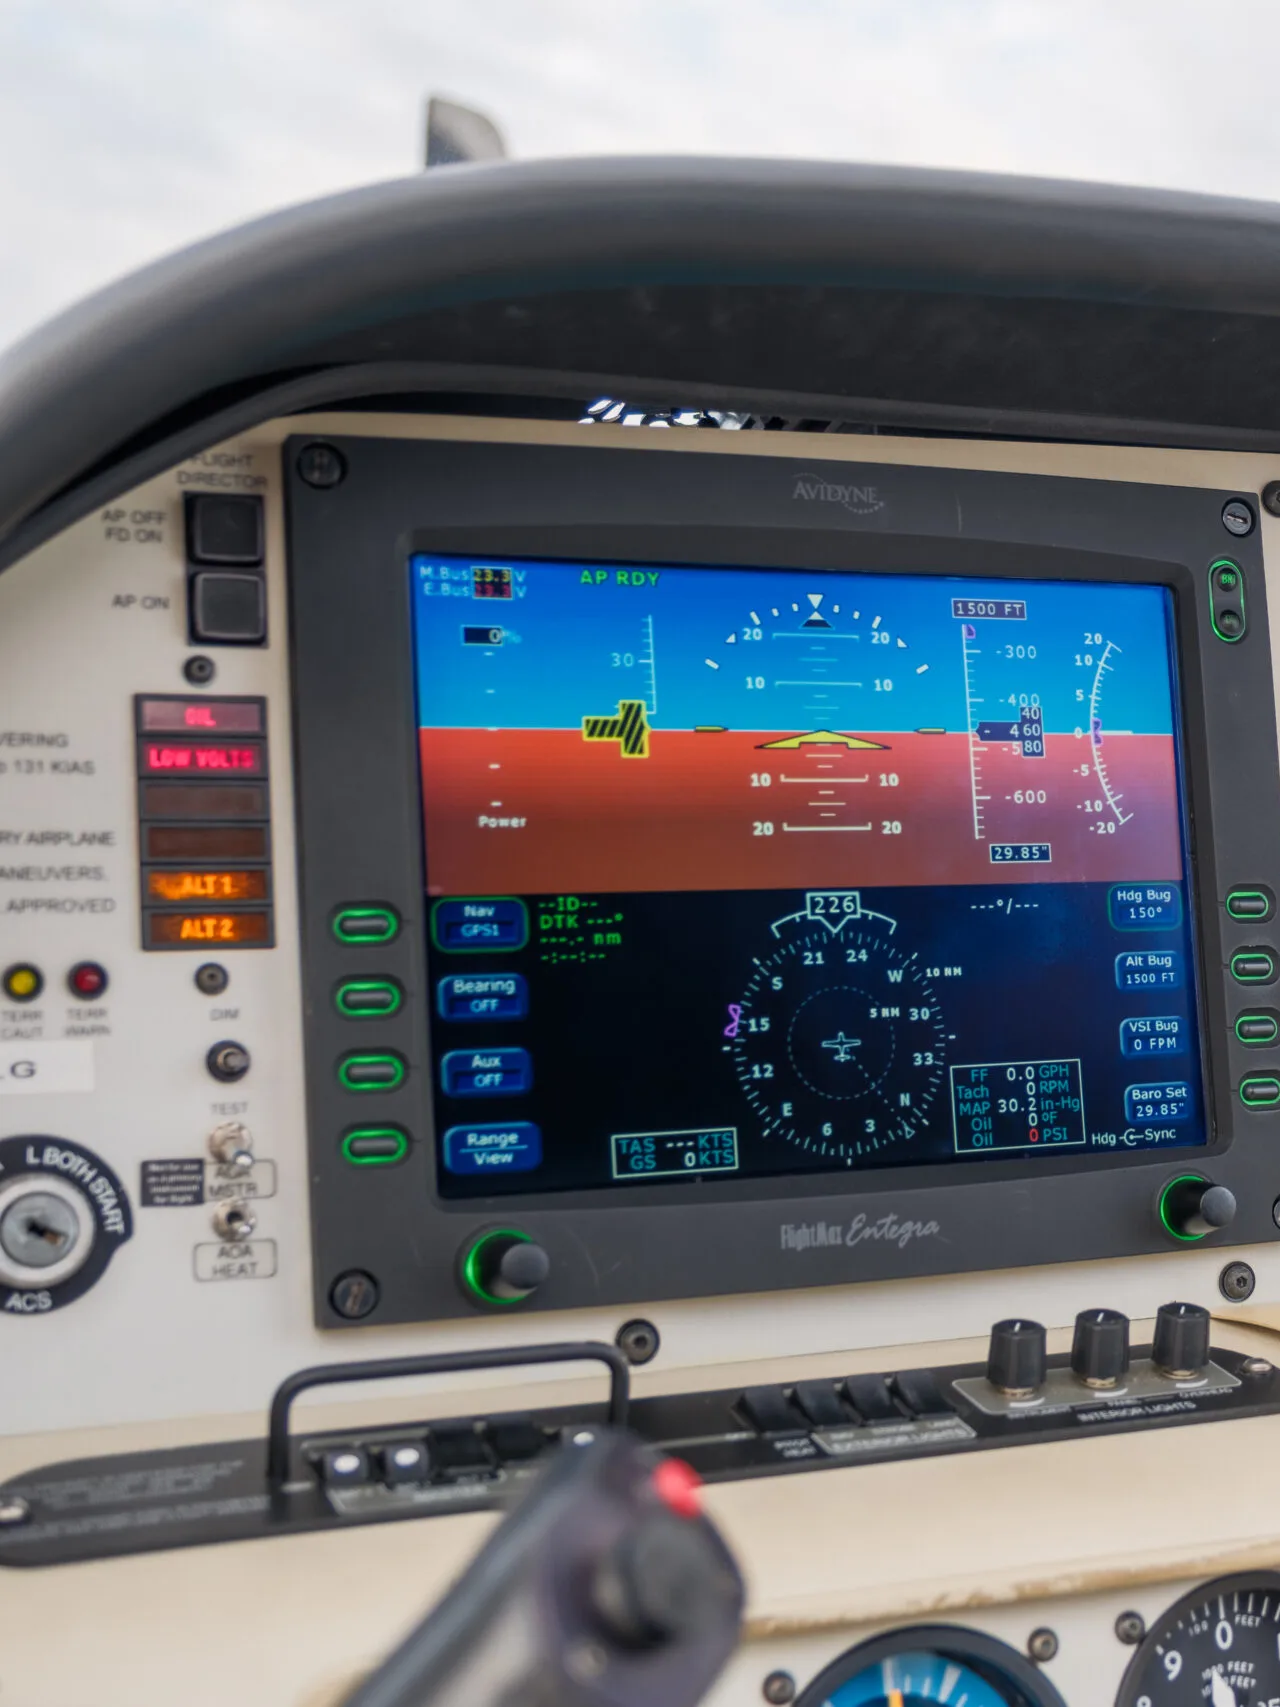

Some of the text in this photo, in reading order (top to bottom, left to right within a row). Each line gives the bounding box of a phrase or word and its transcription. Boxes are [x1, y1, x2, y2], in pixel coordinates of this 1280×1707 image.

[792, 481, 877, 504] AVIDYNE
[102, 509, 167, 526] AP OFF
[105, 528, 163, 543] FD ON
[580, 570, 660, 586] AP RDY
[112, 595, 170, 611] AP ON
[955, 603, 1023, 617] 1500 FT
[996, 646, 1037, 659] -300
[149, 748, 255, 768] LOW VOLTS
[1005, 790, 1047, 804] -600
[478, 815, 527, 828] Power
[992, 846, 1049, 860] 29.85"
[180, 875, 233, 894] ALT 1
[1117, 890, 1171, 903] Hdg Bug
[464, 905, 494, 918] Nav
[813, 896, 855, 914] 226
[180, 919, 234, 939] ALT 2
[540, 914, 579, 930] DTK
[803, 952, 825, 965] 21
[846, 949, 868, 962] 24
[1126, 955, 1172, 969] Alt Bug
[1126, 972, 1175, 985] 1500 FT
[453, 978, 516, 995] Bearing
[470, 1000, 499, 1013] OFF
[909, 1008, 930, 1020] 30
[749, 1018, 770, 1032] 15
[1129, 1020, 1178, 1033] VSI Bug
[472, 1055, 501, 1069] Aux
[913, 1052, 933, 1066] 33
[10, 1061, 36, 1079] G
[752, 1065, 773, 1078] 12
[971, 1064, 1069, 1082] FF 0.0 GPH
[474, 1073, 503, 1087] OFF
[957, 1080, 1069, 1099] Tach 0 RPM
[1132, 1087, 1187, 1100] Baro Set
[959, 1097, 1080, 1116] MAP 30.2 in-Hg
[467, 1132, 519, 1148] Range
[1092, 1132, 1116, 1146] Hdg
[1145, 1128, 1176, 1141] Sync
[618, 1137, 656, 1154] TAS
[26, 1145, 41, 1165] L
[474, 1151, 513, 1165] View
[42, 1146, 97, 1185] BOTH
[630, 1156, 656, 1170] GS
[89, 1176, 125, 1235] START
[780, 1212, 940, 1251] FlightMax Entegra
[212, 1262, 259, 1277] HEAT
[5, 1290, 52, 1312] ACS
[1215, 1620, 1233, 1650] 0
[1164, 1650, 1182, 1680] 9
